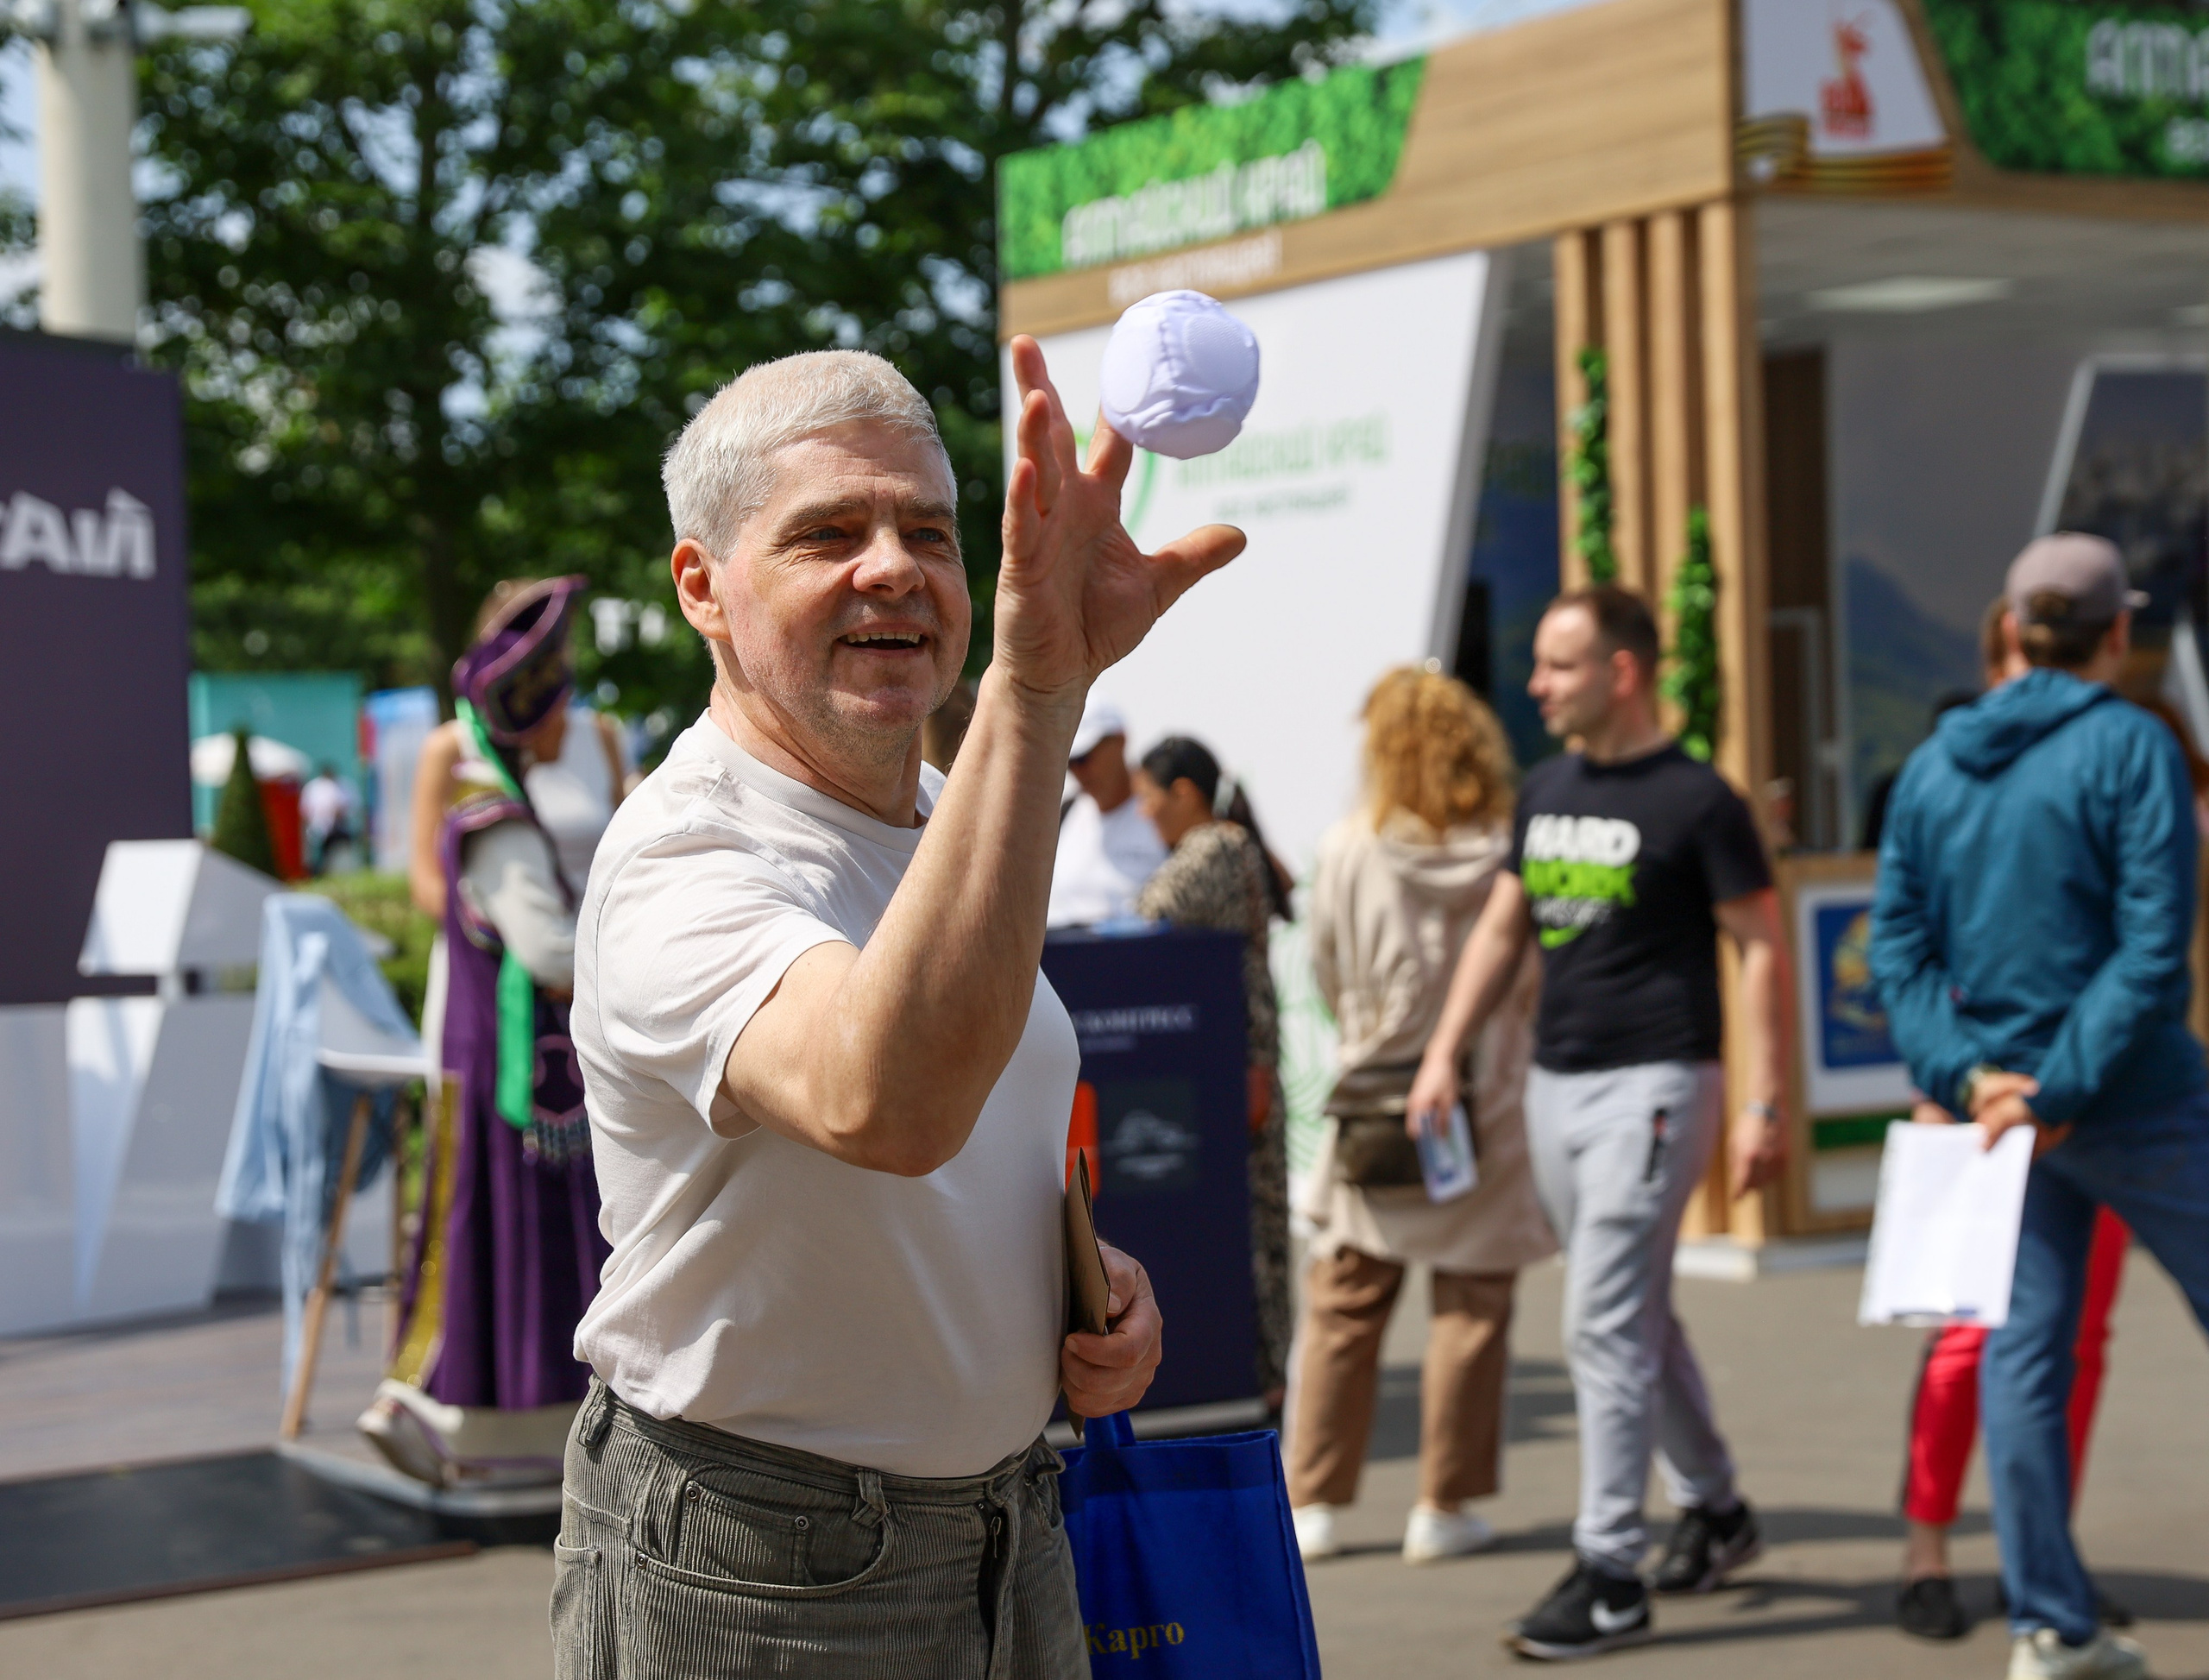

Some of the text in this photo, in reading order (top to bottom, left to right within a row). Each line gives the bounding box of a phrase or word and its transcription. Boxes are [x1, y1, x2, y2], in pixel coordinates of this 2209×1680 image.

[0, 487, 158, 581] АЙ
[1523, 813, 1641, 868] HARD
[1084, 1622, 1185, 1659] Карго
